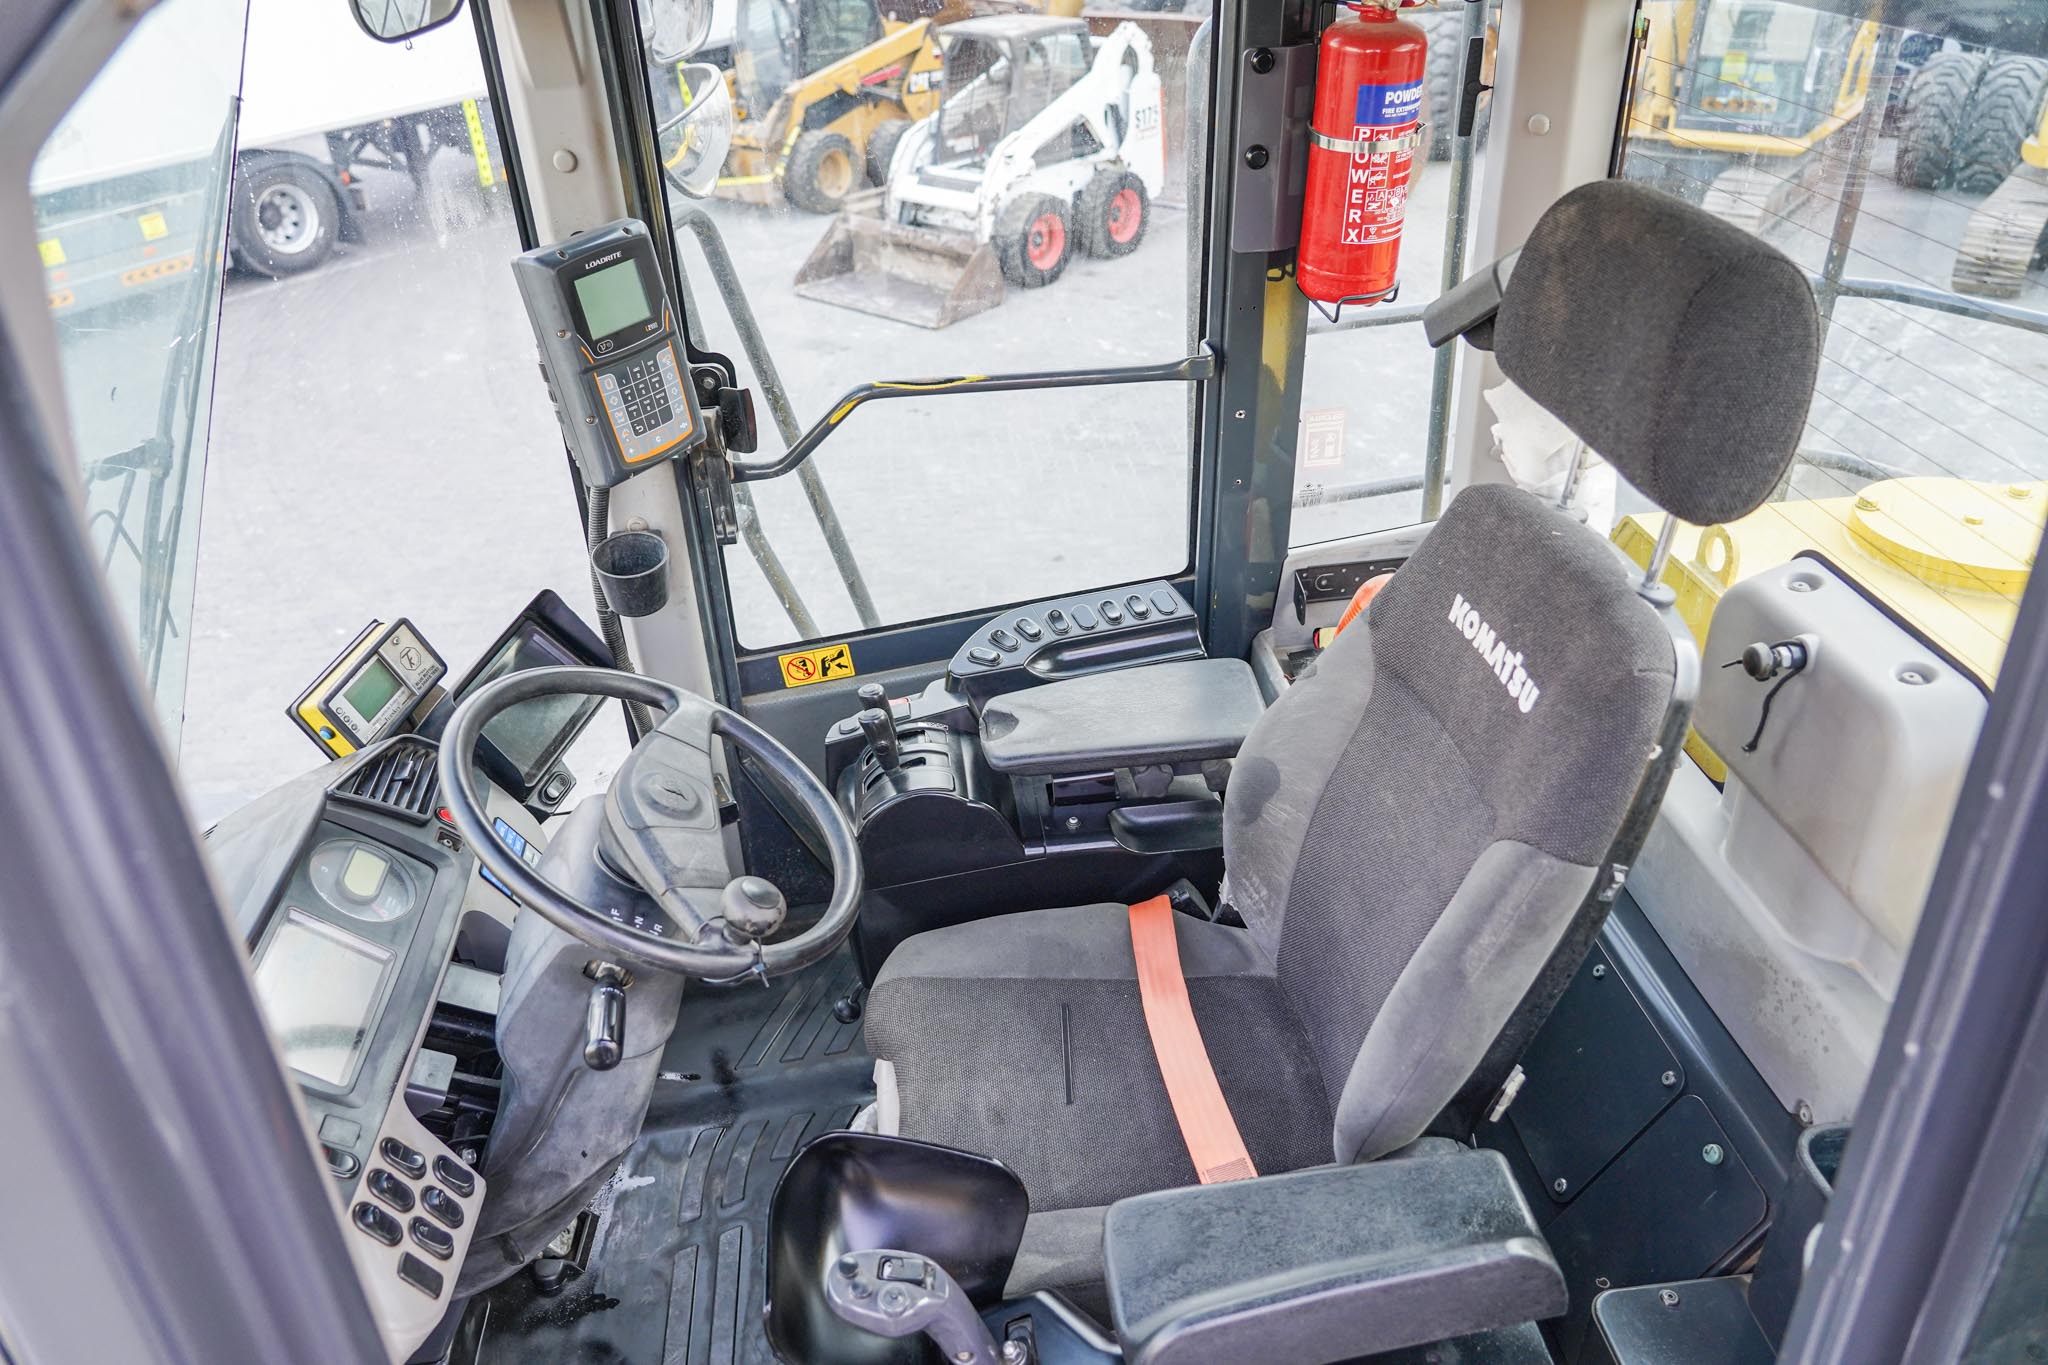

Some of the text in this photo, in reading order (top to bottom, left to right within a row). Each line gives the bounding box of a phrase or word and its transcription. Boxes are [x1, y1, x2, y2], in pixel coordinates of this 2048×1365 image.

[1385, 84, 1423, 105] POWDE
[585, 250, 622, 270] LOADRITE
[1448, 593, 1540, 713] KOMATSU
[422, 664, 435, 678] BUTTON
[611, 908, 620, 916] F
[634, 915, 644, 925] N
[654, 924, 663, 932] R
